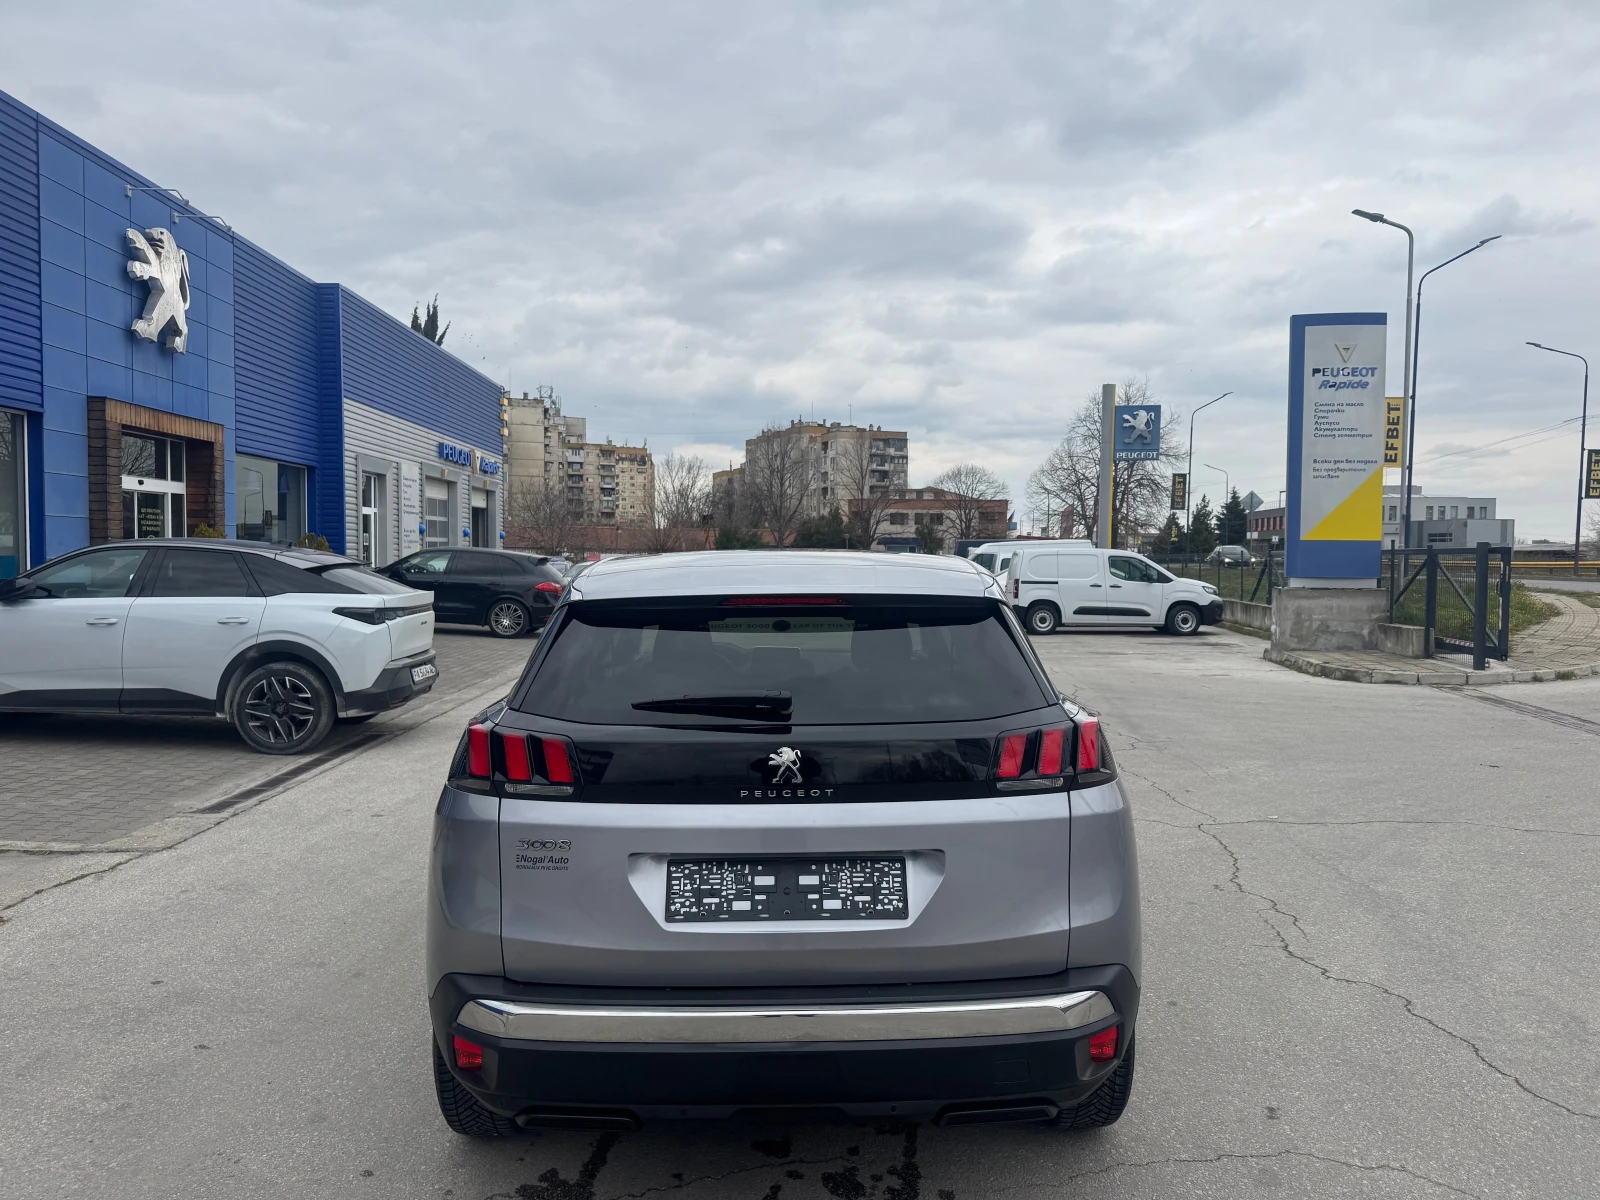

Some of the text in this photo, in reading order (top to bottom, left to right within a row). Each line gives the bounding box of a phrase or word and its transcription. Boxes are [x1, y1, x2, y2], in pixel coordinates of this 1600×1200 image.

[1312, 367, 1377, 377] PEUGEOT
[1318, 380, 1369, 391] Rapide
[1384, 402, 1400, 463] EFBET
[1116, 451, 1158, 459] PEUGEOT
[1175, 476, 1184, 508] EFBET
[740, 789, 834, 797] PEUGEOT
[515, 838, 571, 851] 3008
